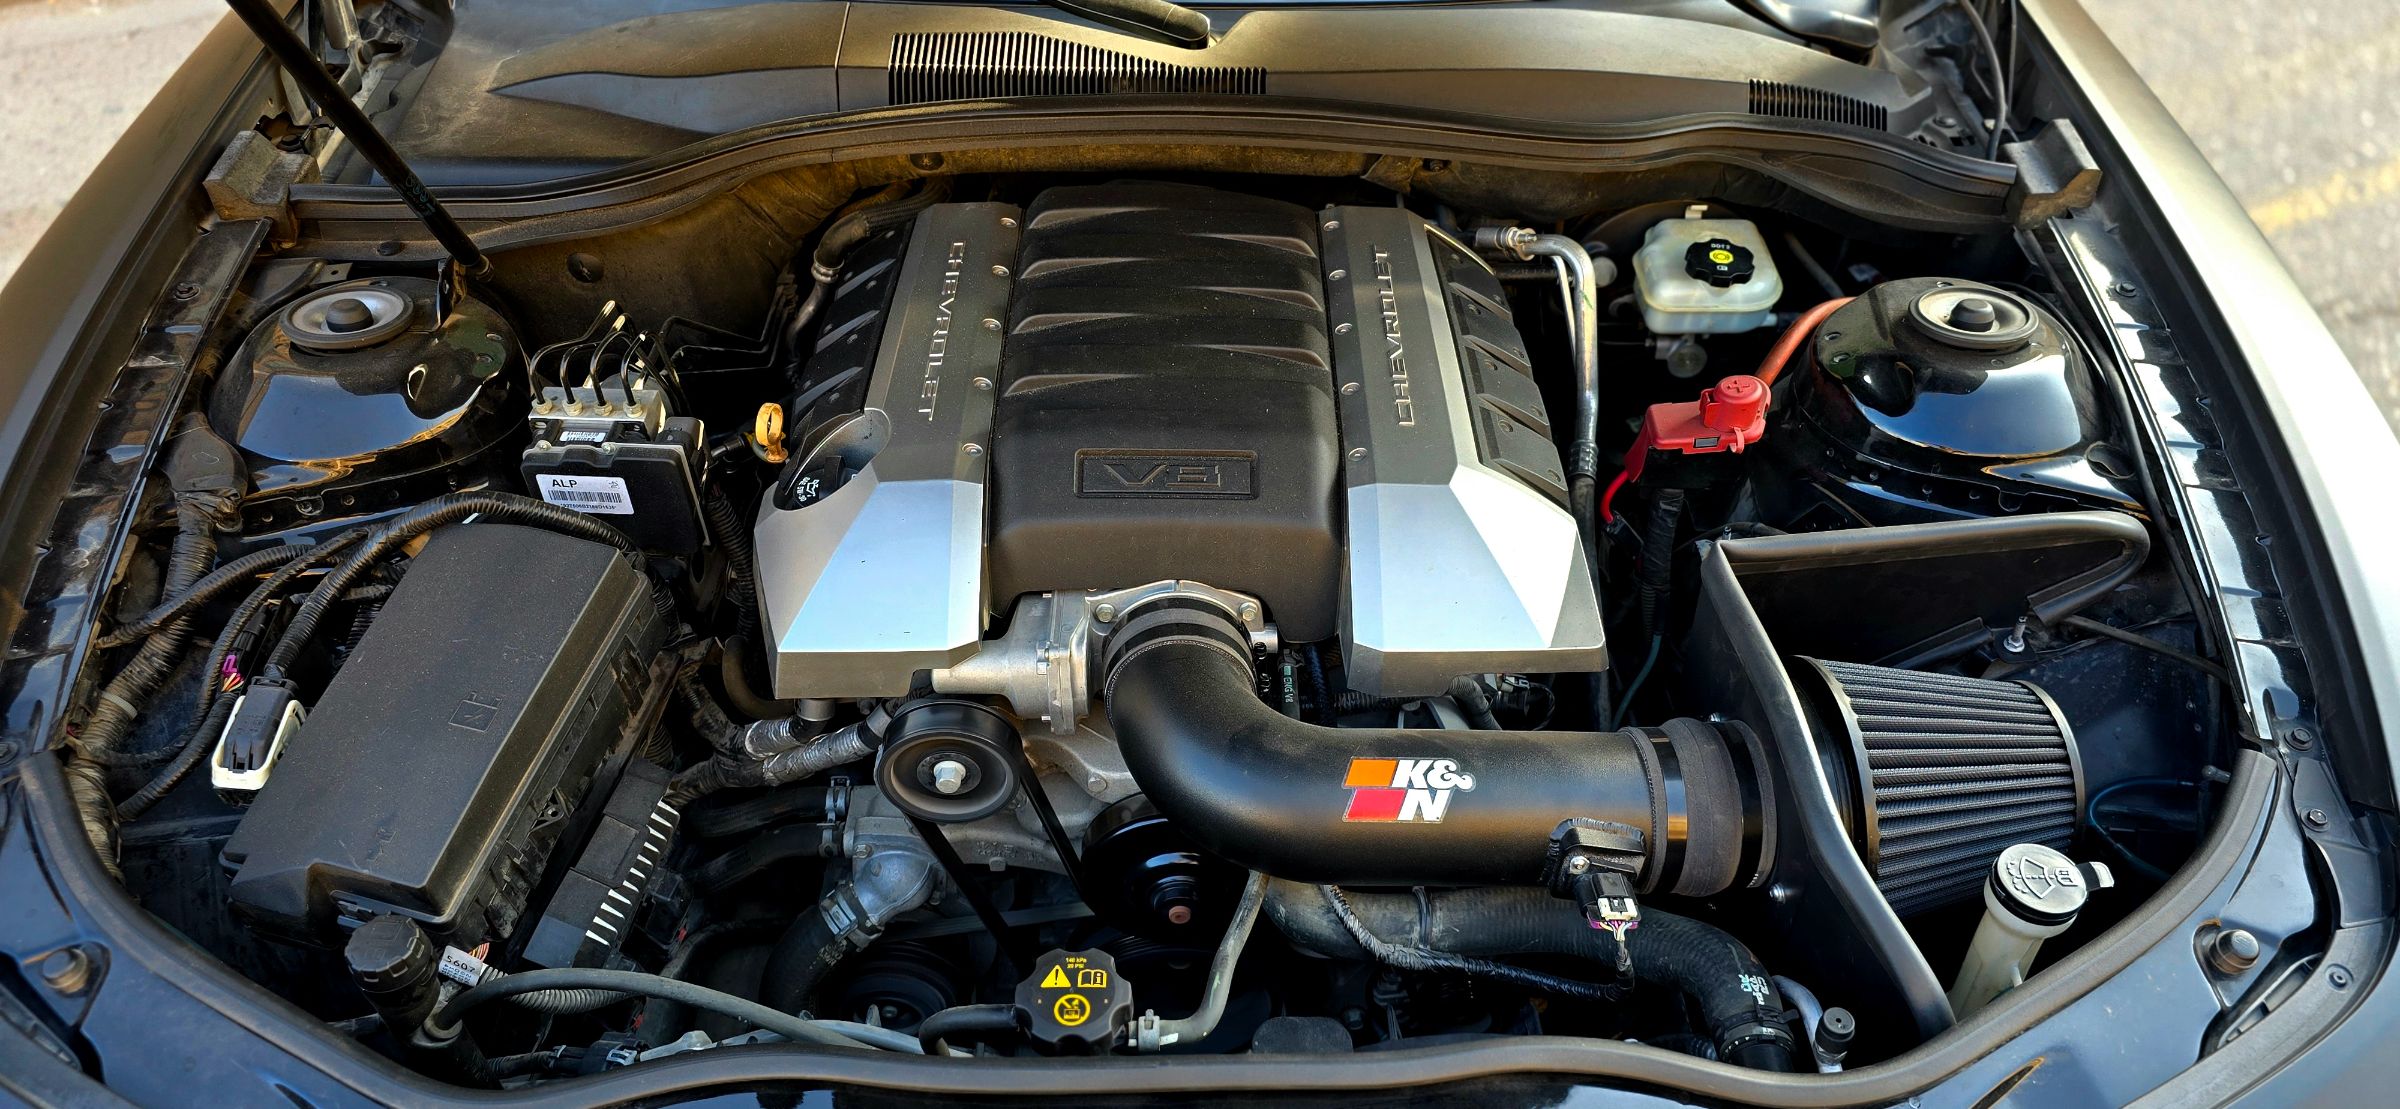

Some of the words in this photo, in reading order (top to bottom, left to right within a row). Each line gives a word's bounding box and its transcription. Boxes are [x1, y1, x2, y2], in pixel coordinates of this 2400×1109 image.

[918, 240, 966, 421] CHEVROLET
[1372, 243, 1415, 426] CHEVROLET
[552, 479, 578, 488] ALP
[1103, 463, 1221, 488] V8
